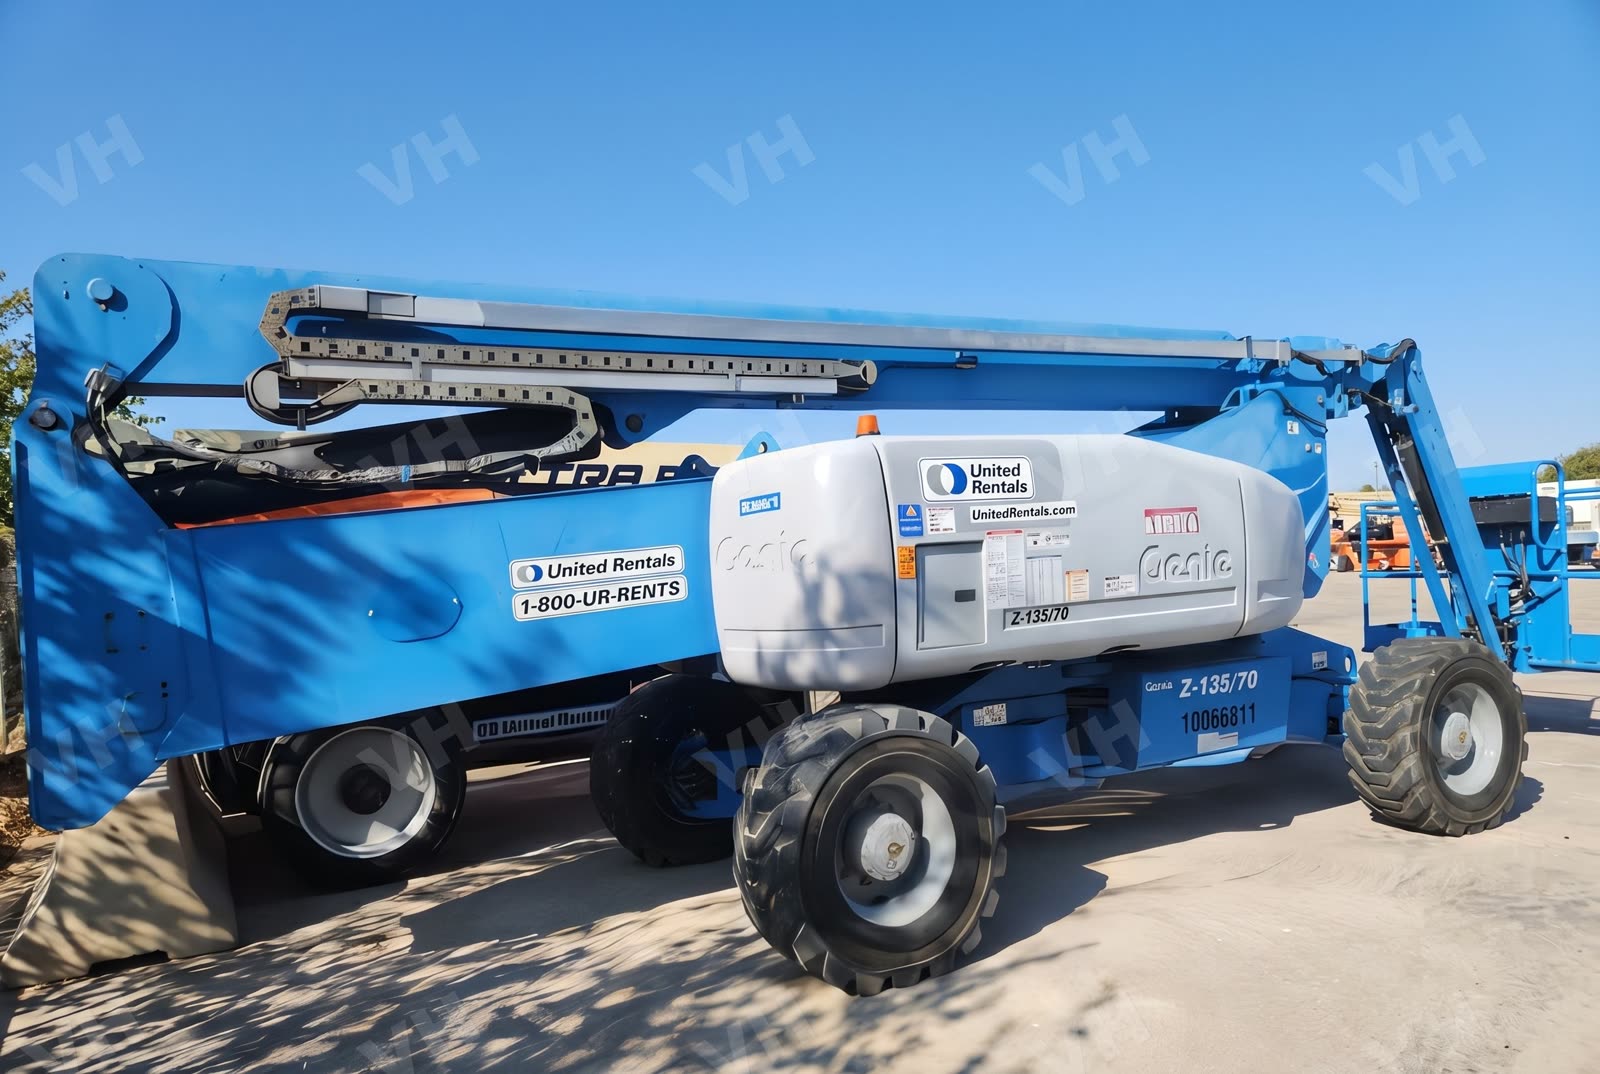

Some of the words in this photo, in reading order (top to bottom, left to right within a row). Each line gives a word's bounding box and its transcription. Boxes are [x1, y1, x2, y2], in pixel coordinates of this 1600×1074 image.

[970, 463, 1020, 478] United
[972, 480, 1028, 494] Rentals
[972, 505, 1076, 521] UnitedRentals.com
[547, 558, 608, 579] United
[612, 553, 676, 573] Rentals
[520, 580, 680, 615] 1-800-UR-RENTS
[1010, 606, 1069, 626] Z-135/70
[1179, 670, 1258, 699] Z-135/70
[1181, 702, 1256, 734] 10066811
